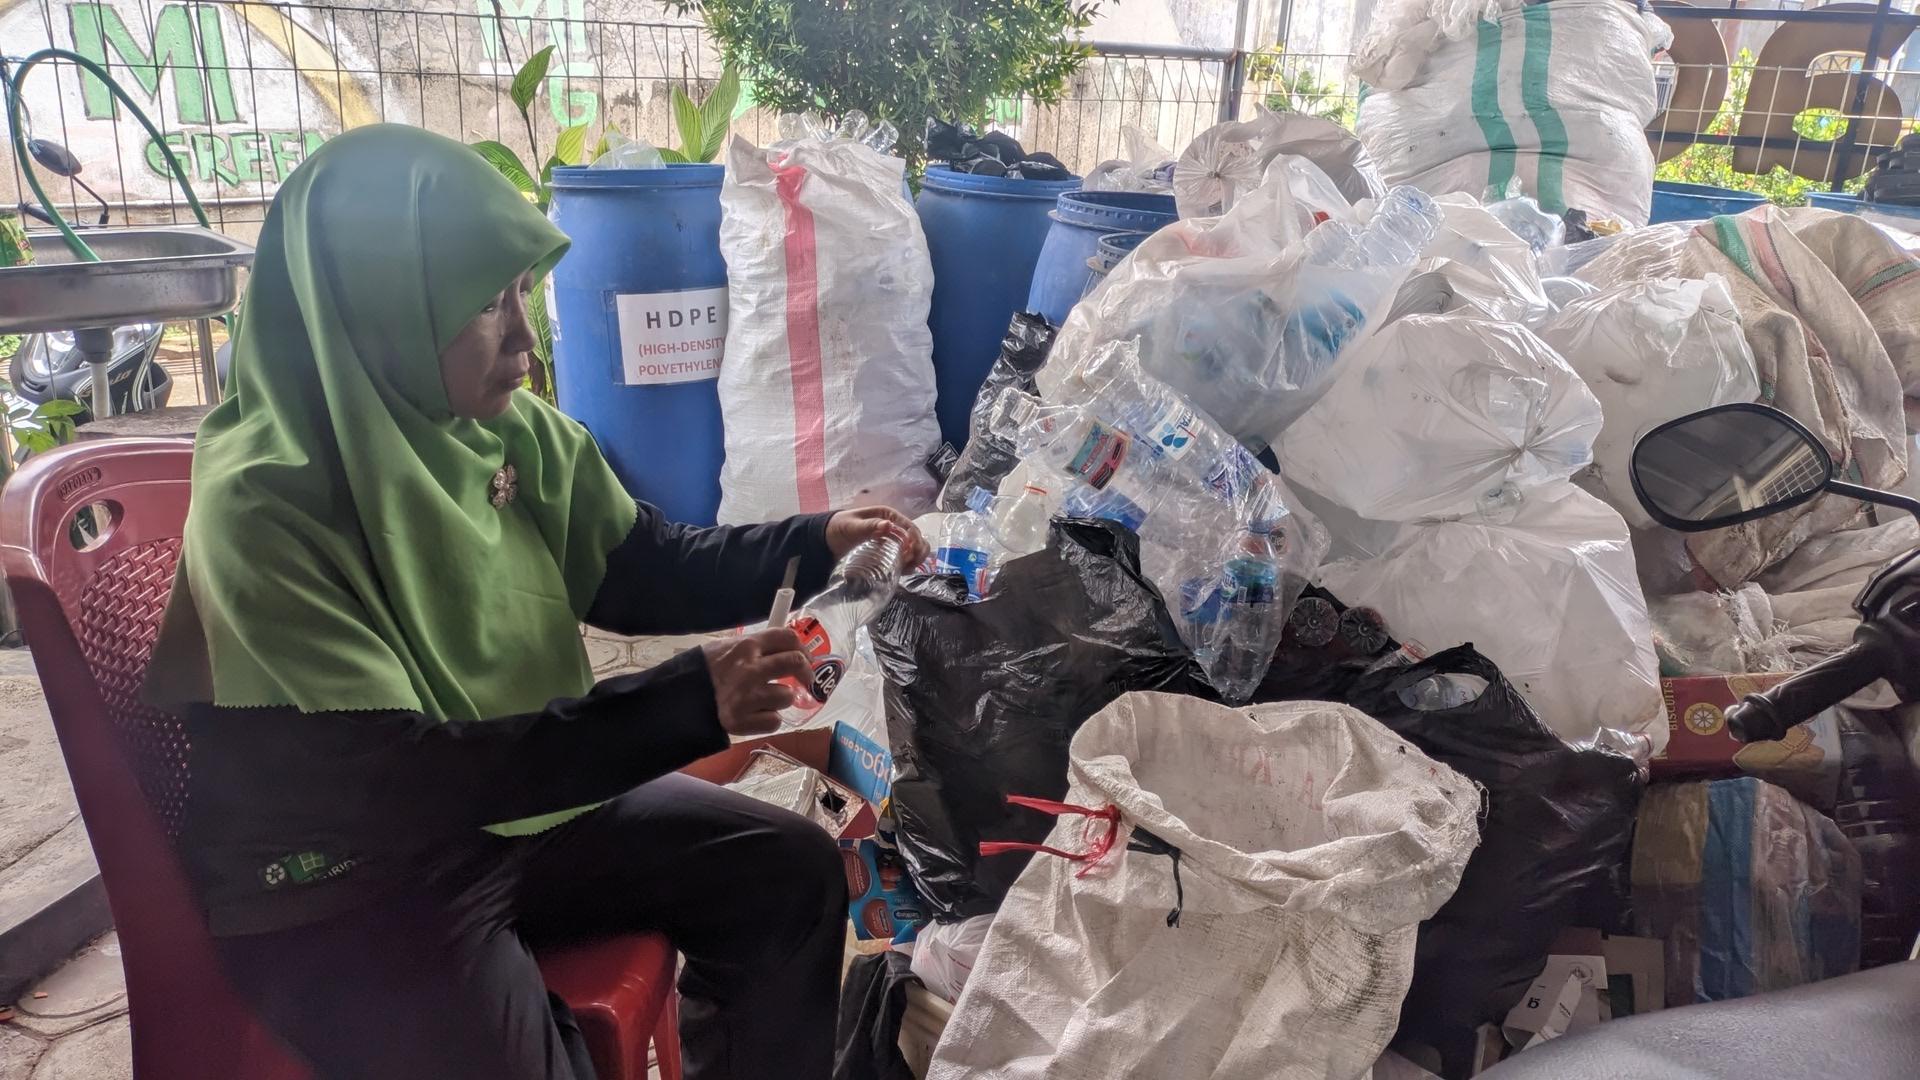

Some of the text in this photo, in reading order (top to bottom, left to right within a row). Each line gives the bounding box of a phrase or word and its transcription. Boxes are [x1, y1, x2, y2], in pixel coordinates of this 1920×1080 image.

[67, 3, 242, 124] MI
[646, 306, 717, 329] HDPE
[639, 359, 724, 376] POLYETHYLEN
[815, 665, 836, 698] Cle
